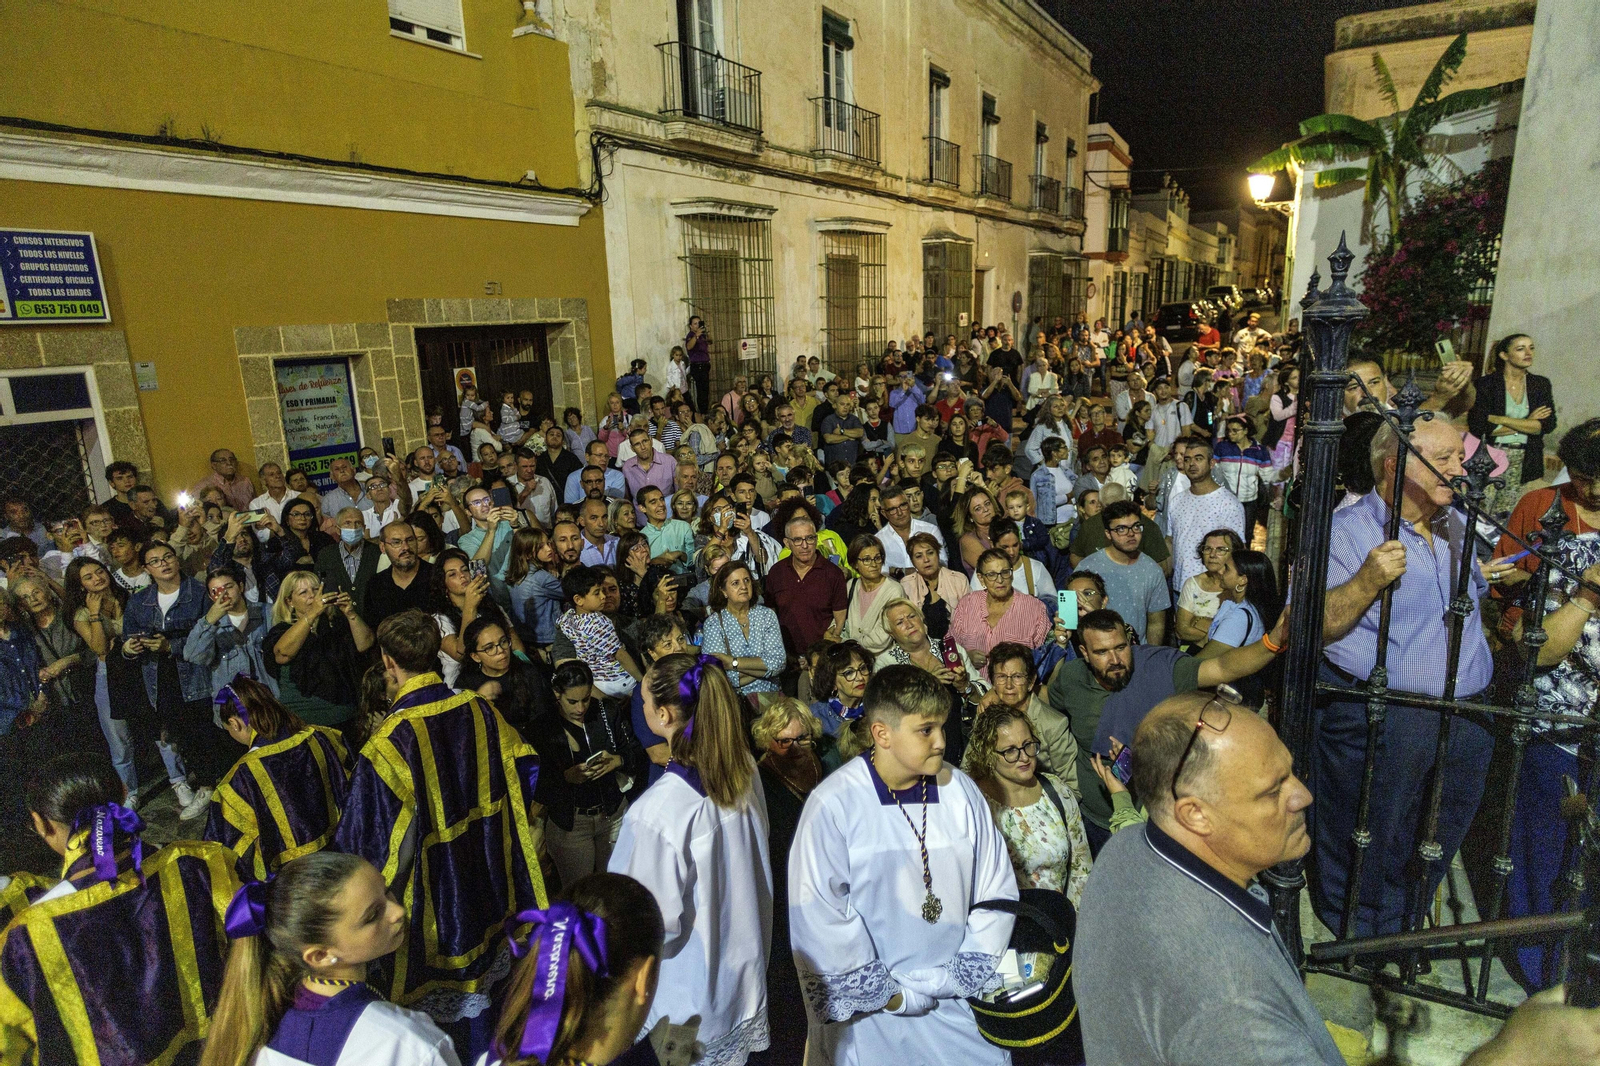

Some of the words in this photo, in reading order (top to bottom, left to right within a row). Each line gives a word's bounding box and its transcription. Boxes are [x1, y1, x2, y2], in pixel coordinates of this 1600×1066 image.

[13, 236, 43, 245] CURSOS
[44, 238, 84, 247] INTENSIVOS
[18, 249, 43, 258] TODOS
[44, 250, 57, 258] LOS
[58, 251, 85, 259] NIVELES
[20, 262, 49, 271] GRUPOS
[50, 263, 89, 272] REDUCIDOS
[20, 275, 64, 284] CERTIFICADOS
[65, 276, 94, 285] OFICIALES
[28, 288, 52, 296] TODAS
[53, 288, 66, 297] LAS
[66, 288, 92, 297] EDADES
[34, 304, 56, 314] 653
[57, 303, 77, 314] 750
[79, 303, 100, 314] 049
[298, 381, 309, 391] de
[286, 399, 299, 408] ESO
[299, 398, 304, 407] Y
[305, 396, 337, 406] PRIMARIA
[298, 461, 317, 472] 653
[96, 810, 106, 856] Nazareno
[544, 917, 569, 1001] Nazareno
